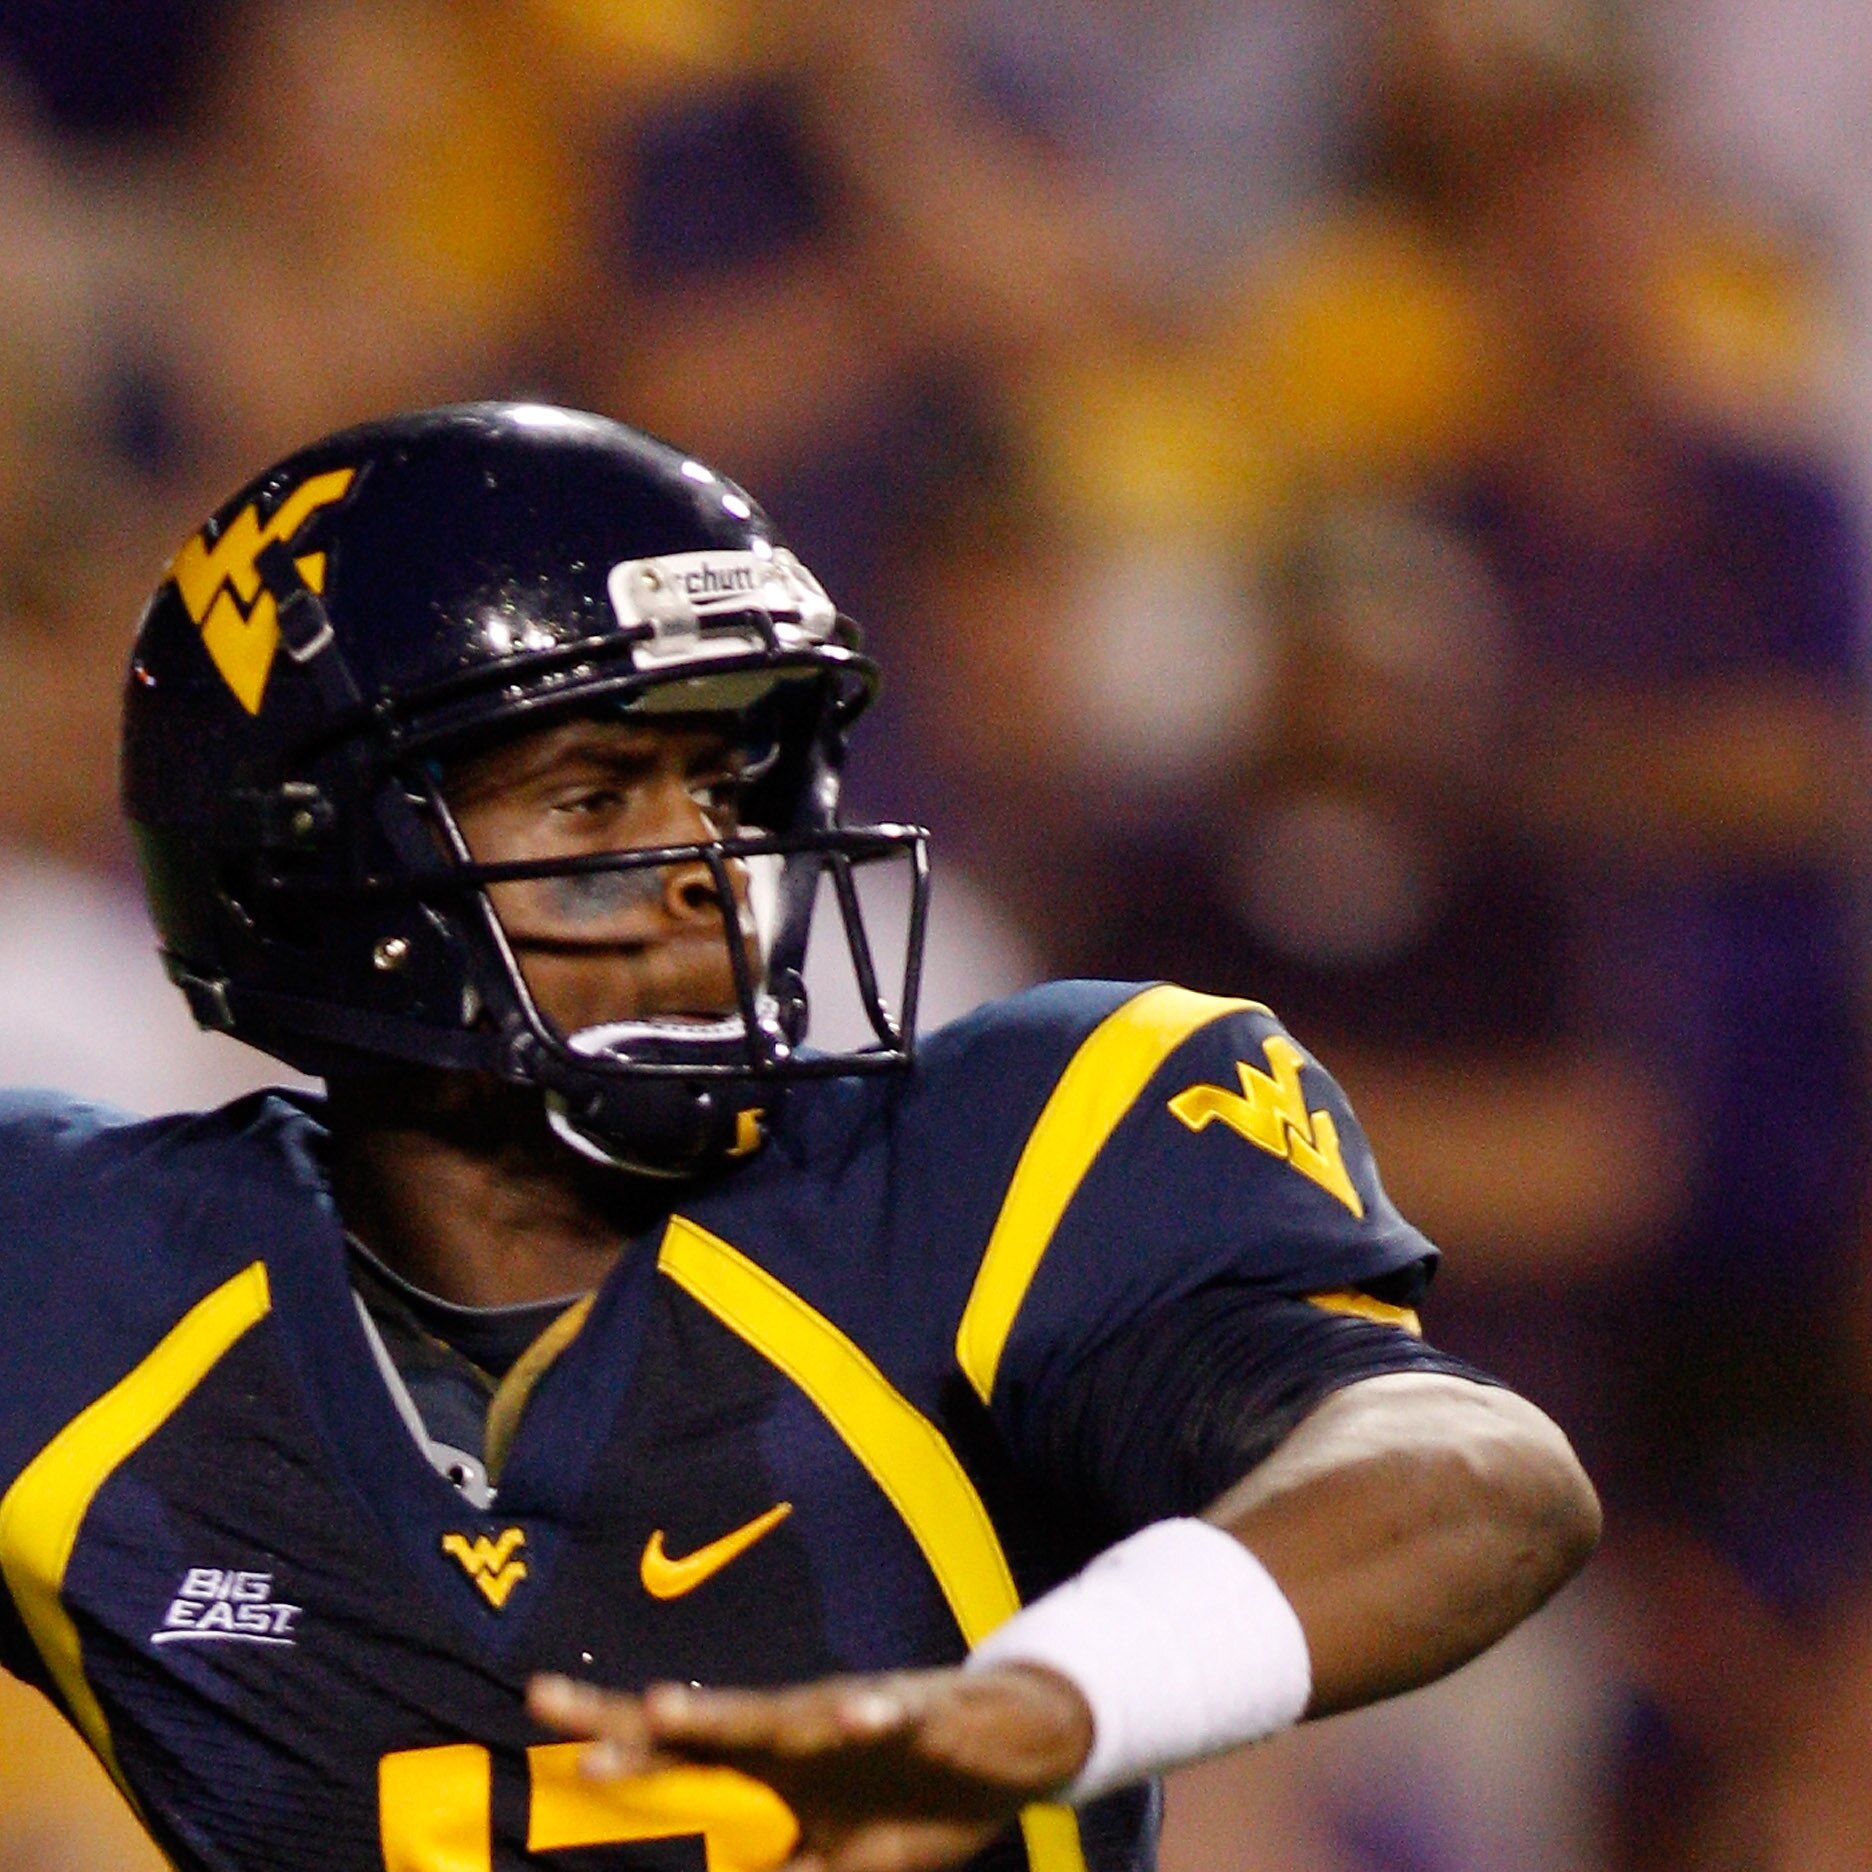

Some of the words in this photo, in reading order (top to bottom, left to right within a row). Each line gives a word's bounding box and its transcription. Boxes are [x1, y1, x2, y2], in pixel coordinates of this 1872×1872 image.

[675, 561, 755, 595] chutt
[178, 1567, 273, 1602] BIG
[164, 1598, 303, 1635] EAST
